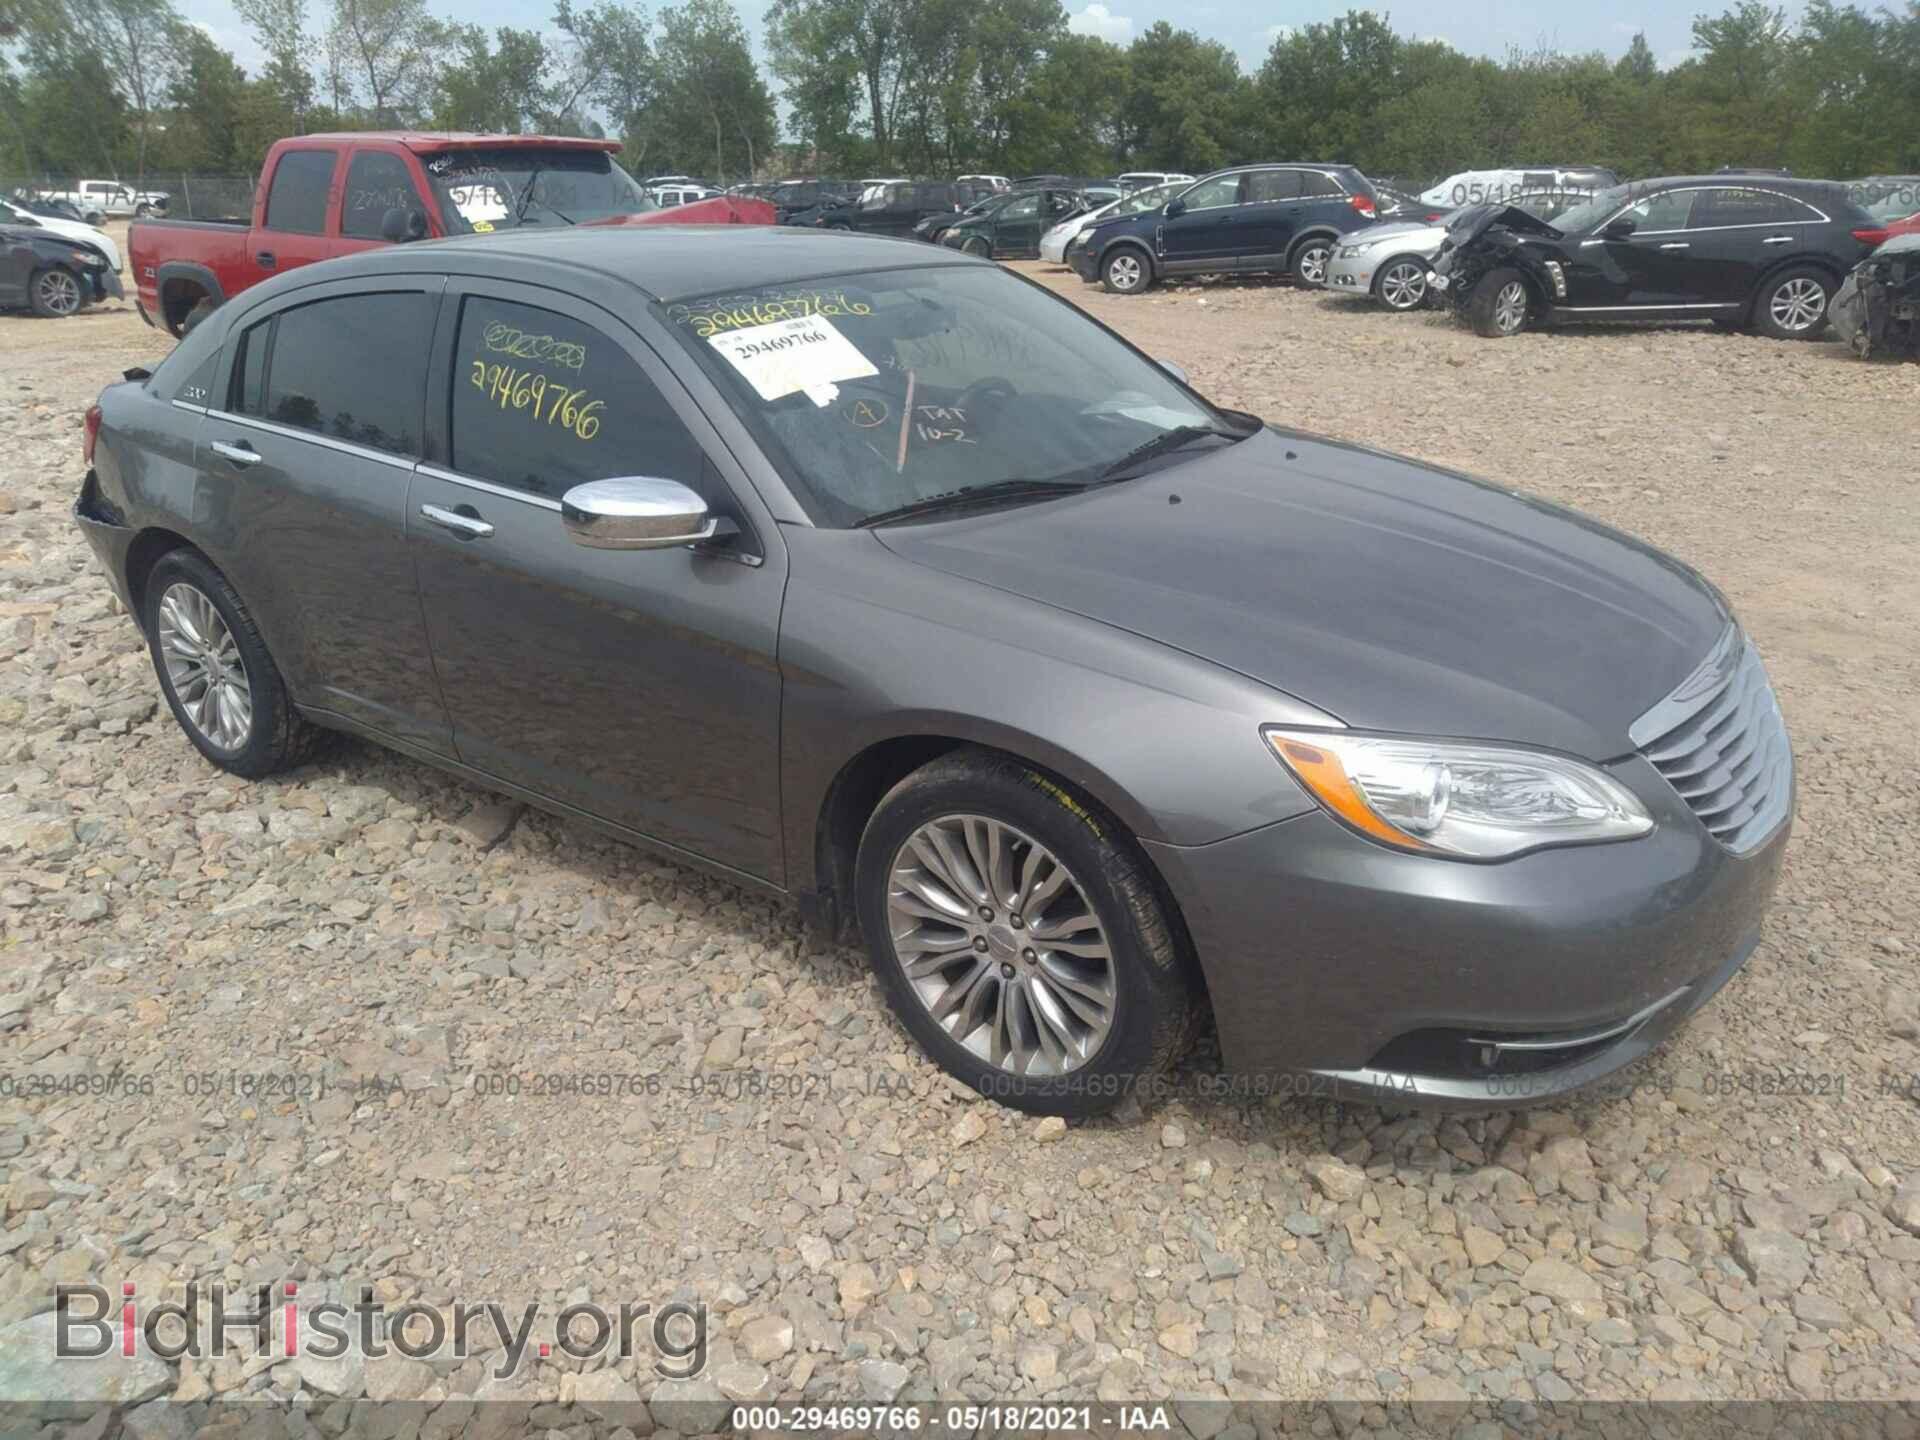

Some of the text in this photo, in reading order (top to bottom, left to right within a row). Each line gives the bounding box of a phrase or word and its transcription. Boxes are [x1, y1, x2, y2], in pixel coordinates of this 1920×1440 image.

[690, 294, 873, 337] 29469766
[735, 330, 827, 359] 29469766
[471, 360, 606, 439] 29469766
